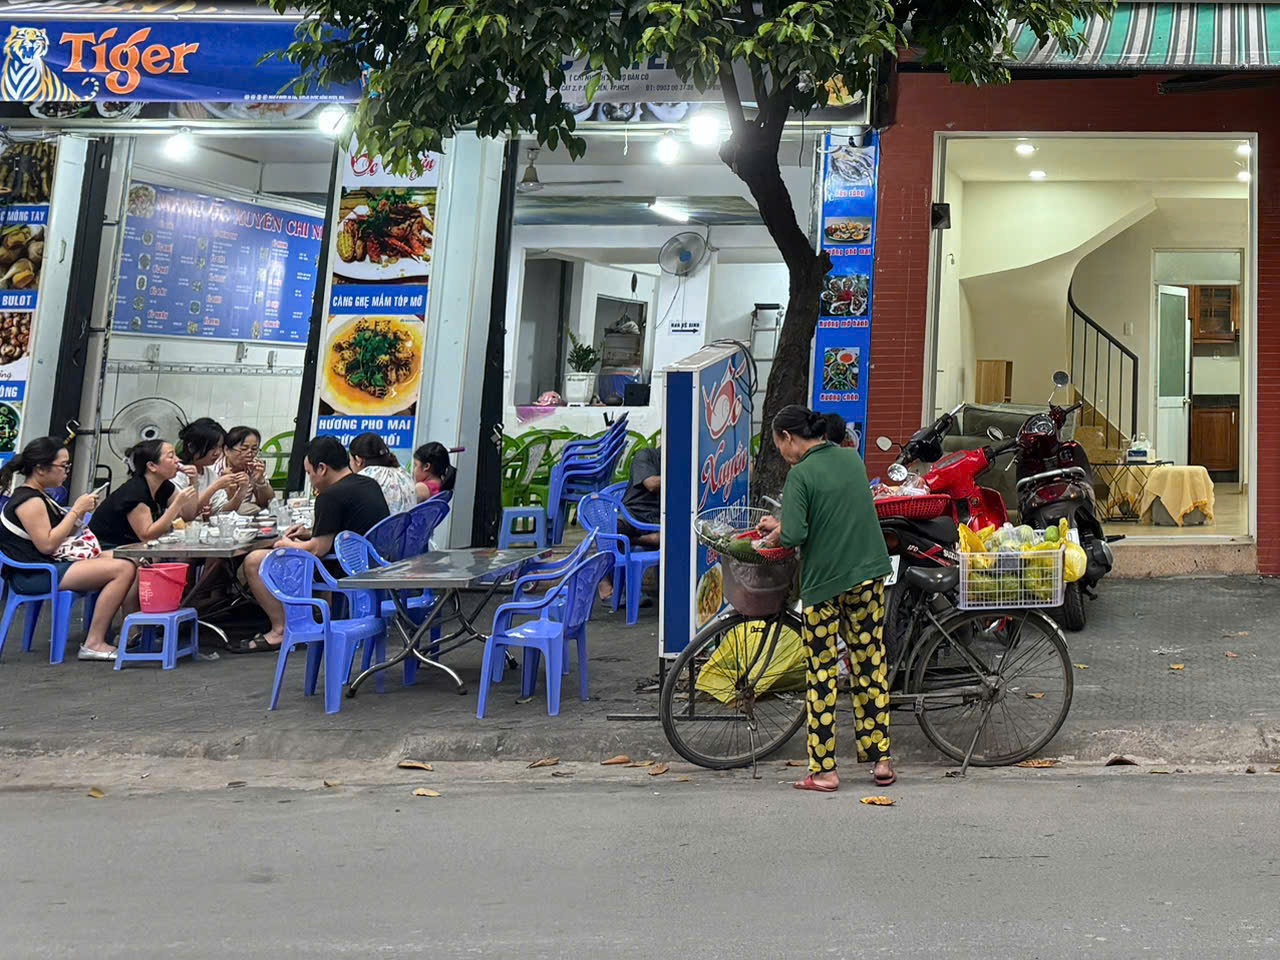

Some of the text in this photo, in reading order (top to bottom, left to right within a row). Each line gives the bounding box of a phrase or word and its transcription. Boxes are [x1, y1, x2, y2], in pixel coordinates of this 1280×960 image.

[60, 27, 200, 95] Tiger
[31, 211, 45, 222] TAY
[286, 220, 308, 239] CHI
[2, 295, 32, 306] BULOT
[355, 296, 370, 309] GHẸ
[360, 419, 384, 430] PHO
[387, 419, 411, 430] MAI
[943, 549, 959, 561] SUZU
